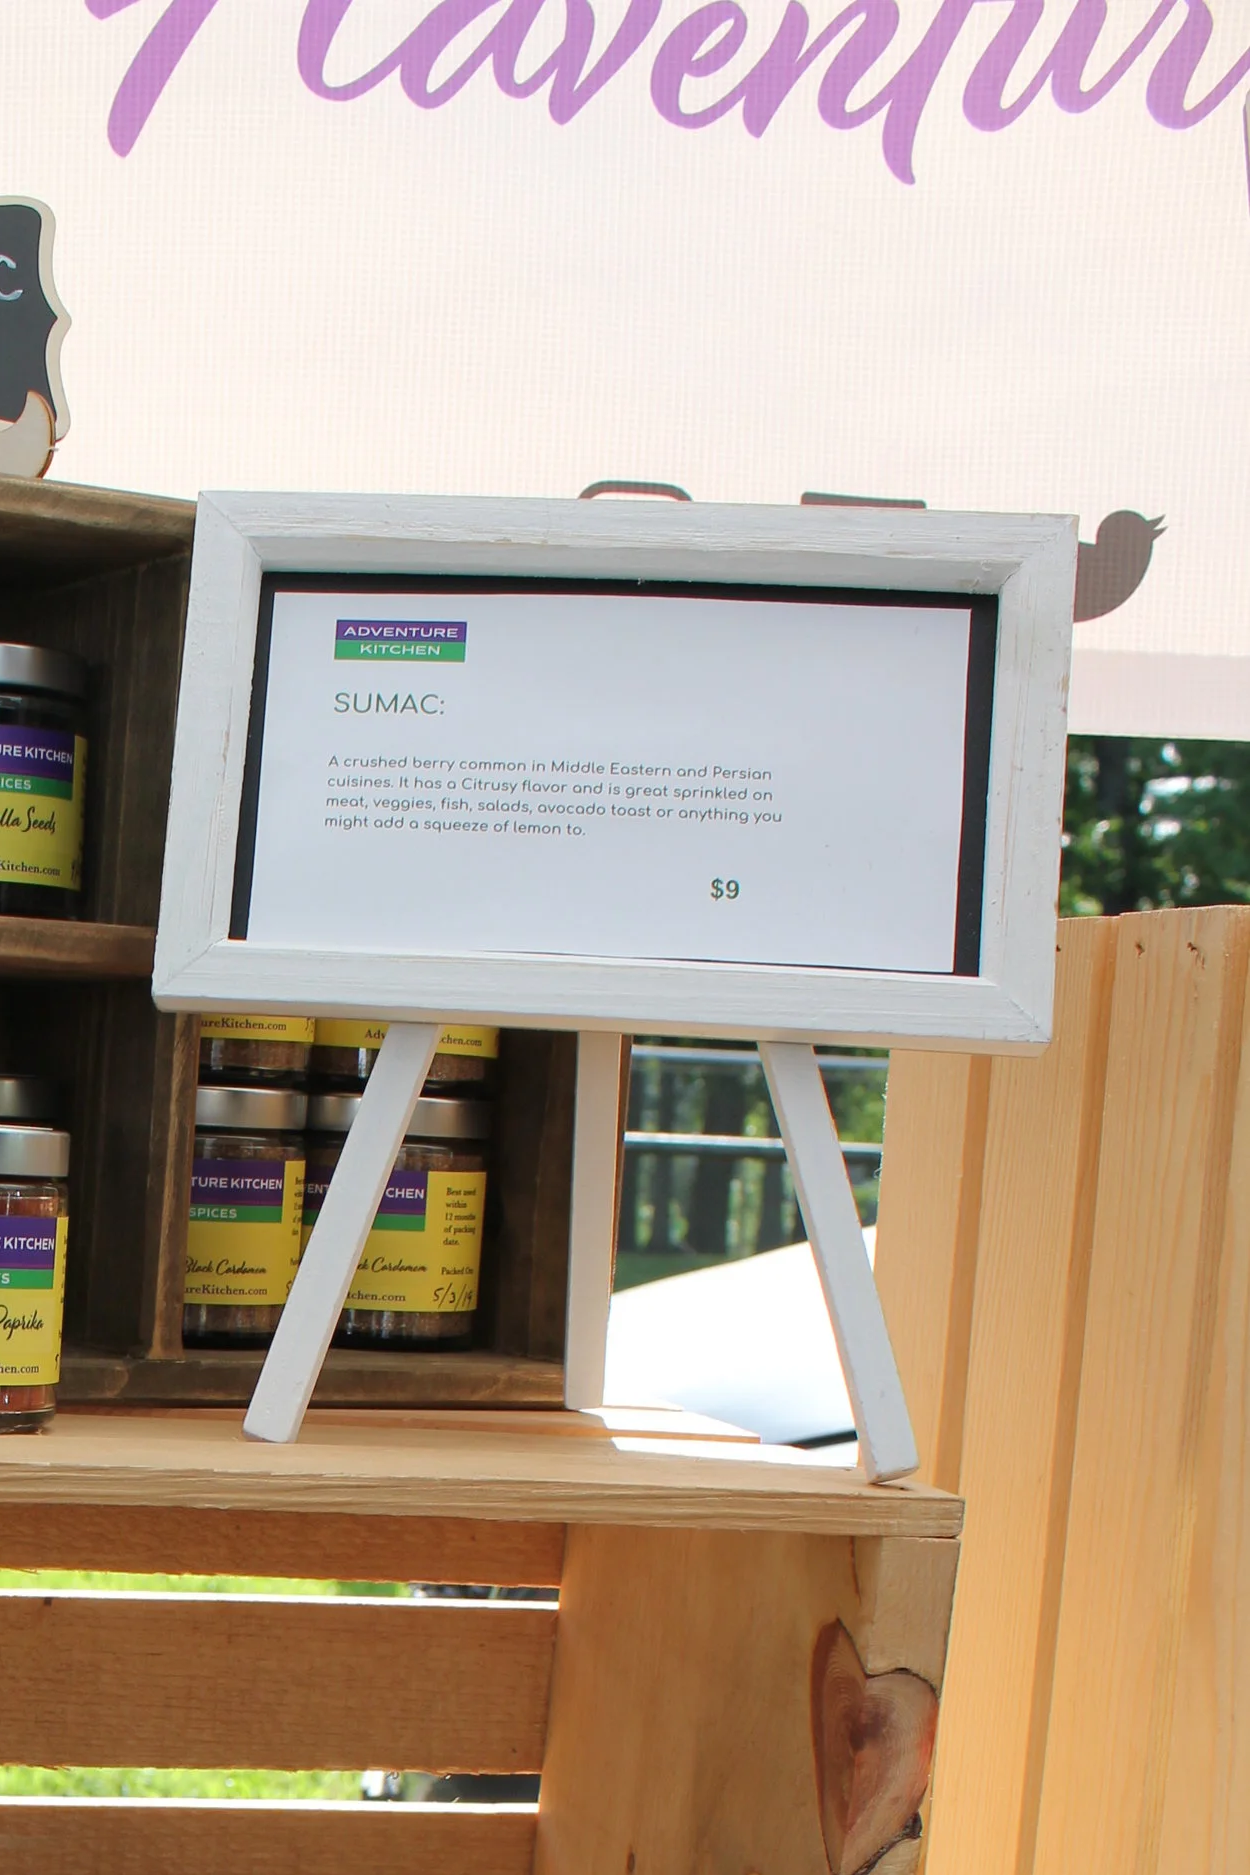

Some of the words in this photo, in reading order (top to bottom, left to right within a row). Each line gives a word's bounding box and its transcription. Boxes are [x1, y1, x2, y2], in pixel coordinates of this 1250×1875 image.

[344, 627, 458, 637] ADVENTURE
[360, 644, 440, 655] KITCHEN
[334, 692, 444, 715] SUMAC:
[328, 755, 339, 767] A
[344, 755, 407, 769] crushed
[413, 756, 455, 772] berry
[459, 759, 526, 772] common
[532, 759, 546, 772] in
[551, 759, 605, 774] Middle
[611, 761, 672, 777] Eastern
[677, 765, 707, 778] and
[713, 765, 772, 781] Persian
[327, 774, 393, 789] cuisines.
[399, 775, 409, 789] It
[414, 775, 442, 789] has
[447, 780, 457, 790] a
[461, 777, 518, 794] Citrusy
[521, 780, 568, 795] flavor
[573, 781, 604, 795] and
[608, 782, 620, 796] is
[625, 784, 669, 800] great
[674, 785, 748, 802] sprinkled
[753, 791, 773, 802] on
[22, 807, 56, 833] Seeds
[325, 795, 368, 810] meat,
[373, 796, 435, 813] veggies,
[441, 796, 473, 813] fish,
[478, 798, 533, 815] salads,
[537, 801, 606, 816] avocado
[610, 803, 652, 818] toast
[656, 808, 675, 819] or
[679, 806, 749, 824] anything
[753, 811, 783, 825] you
[324, 814, 369, 831] might
[374, 815, 405, 829] add
[409, 819, 419, 830] a
[423, 820, 489, 834] squeeze
[493, 819, 510, 833] of
[514, 819, 562, 836] lemon
[566, 823, 586, 836] to.
[711, 878, 740, 901] $9
[231, 1178, 282, 1189] KITCHEN
[189, 1208, 237, 1218] SPICES
